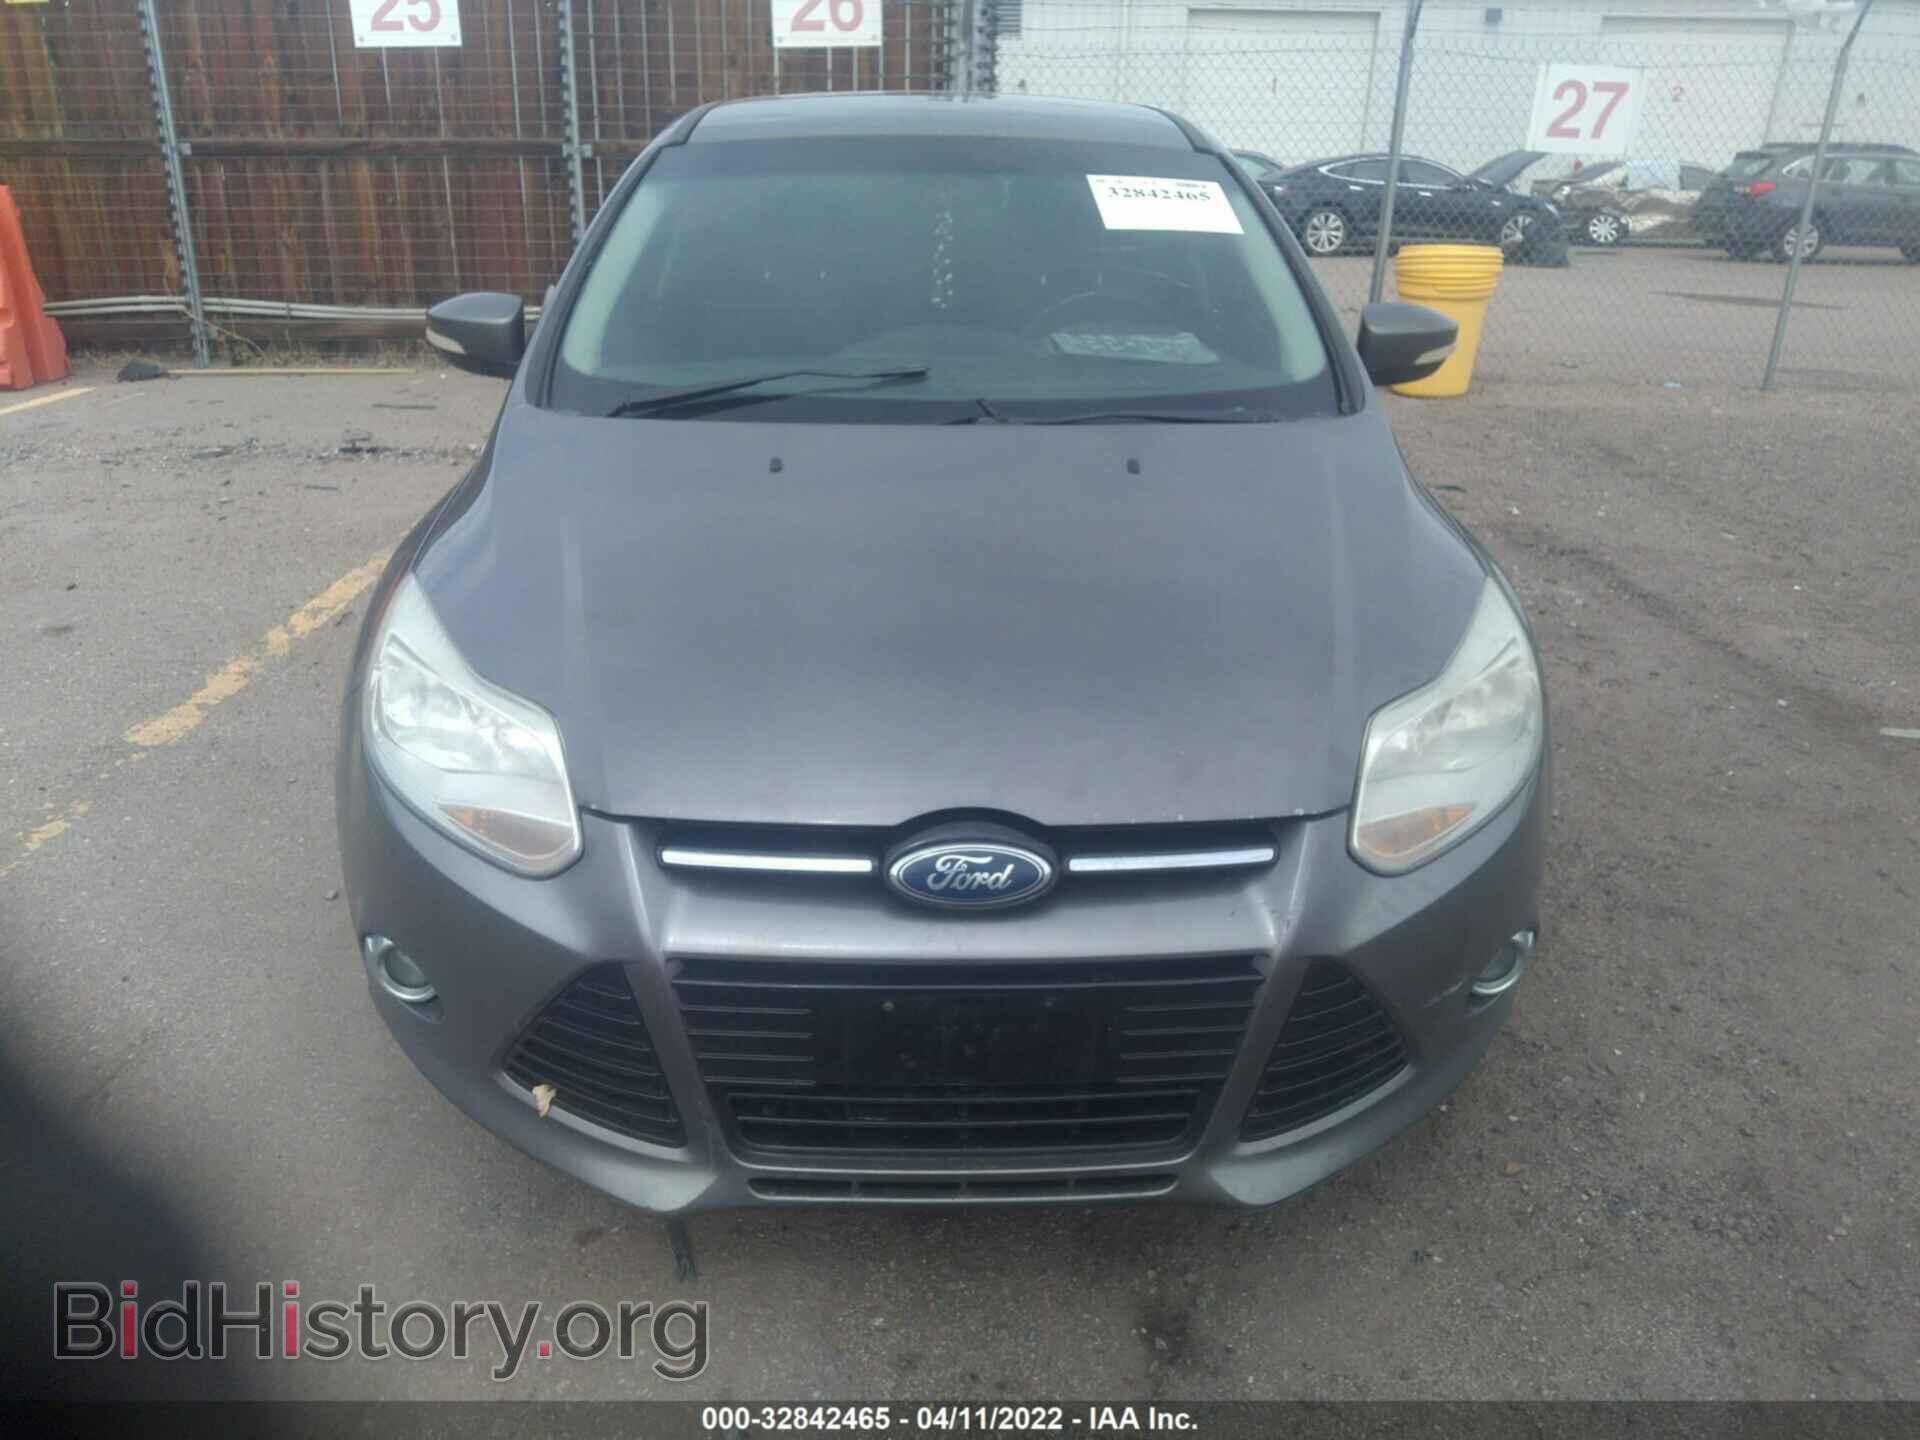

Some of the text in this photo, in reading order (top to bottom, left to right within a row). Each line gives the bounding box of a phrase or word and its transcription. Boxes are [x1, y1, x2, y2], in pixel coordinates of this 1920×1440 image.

[371, 0, 441, 32] 25
[1546, 79, 1630, 138] 27
[927, 855, 1015, 890] Ford
